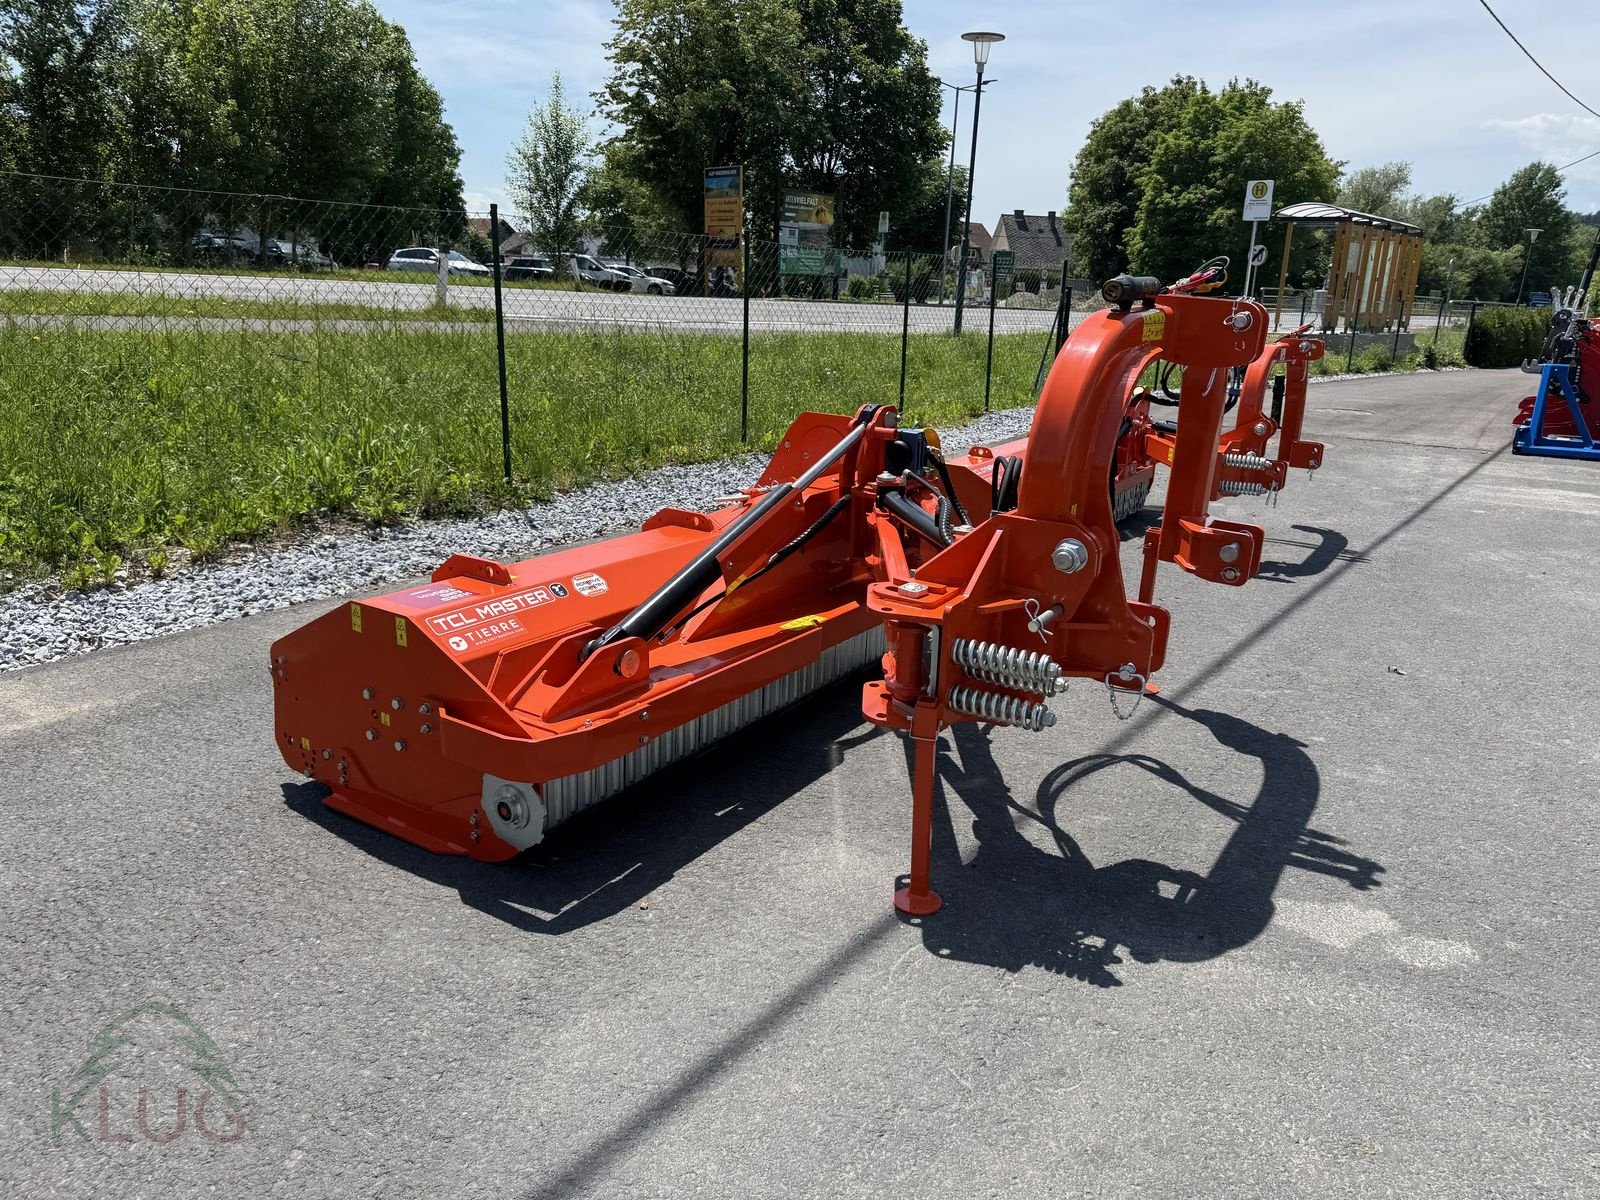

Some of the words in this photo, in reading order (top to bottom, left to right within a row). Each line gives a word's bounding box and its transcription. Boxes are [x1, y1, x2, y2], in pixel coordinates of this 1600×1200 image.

[1255, 184, 1264, 196] H
[433, 613, 478, 631] TCL
[475, 590, 550, 619] MASTER
[464, 619, 519, 641] TIERRE
